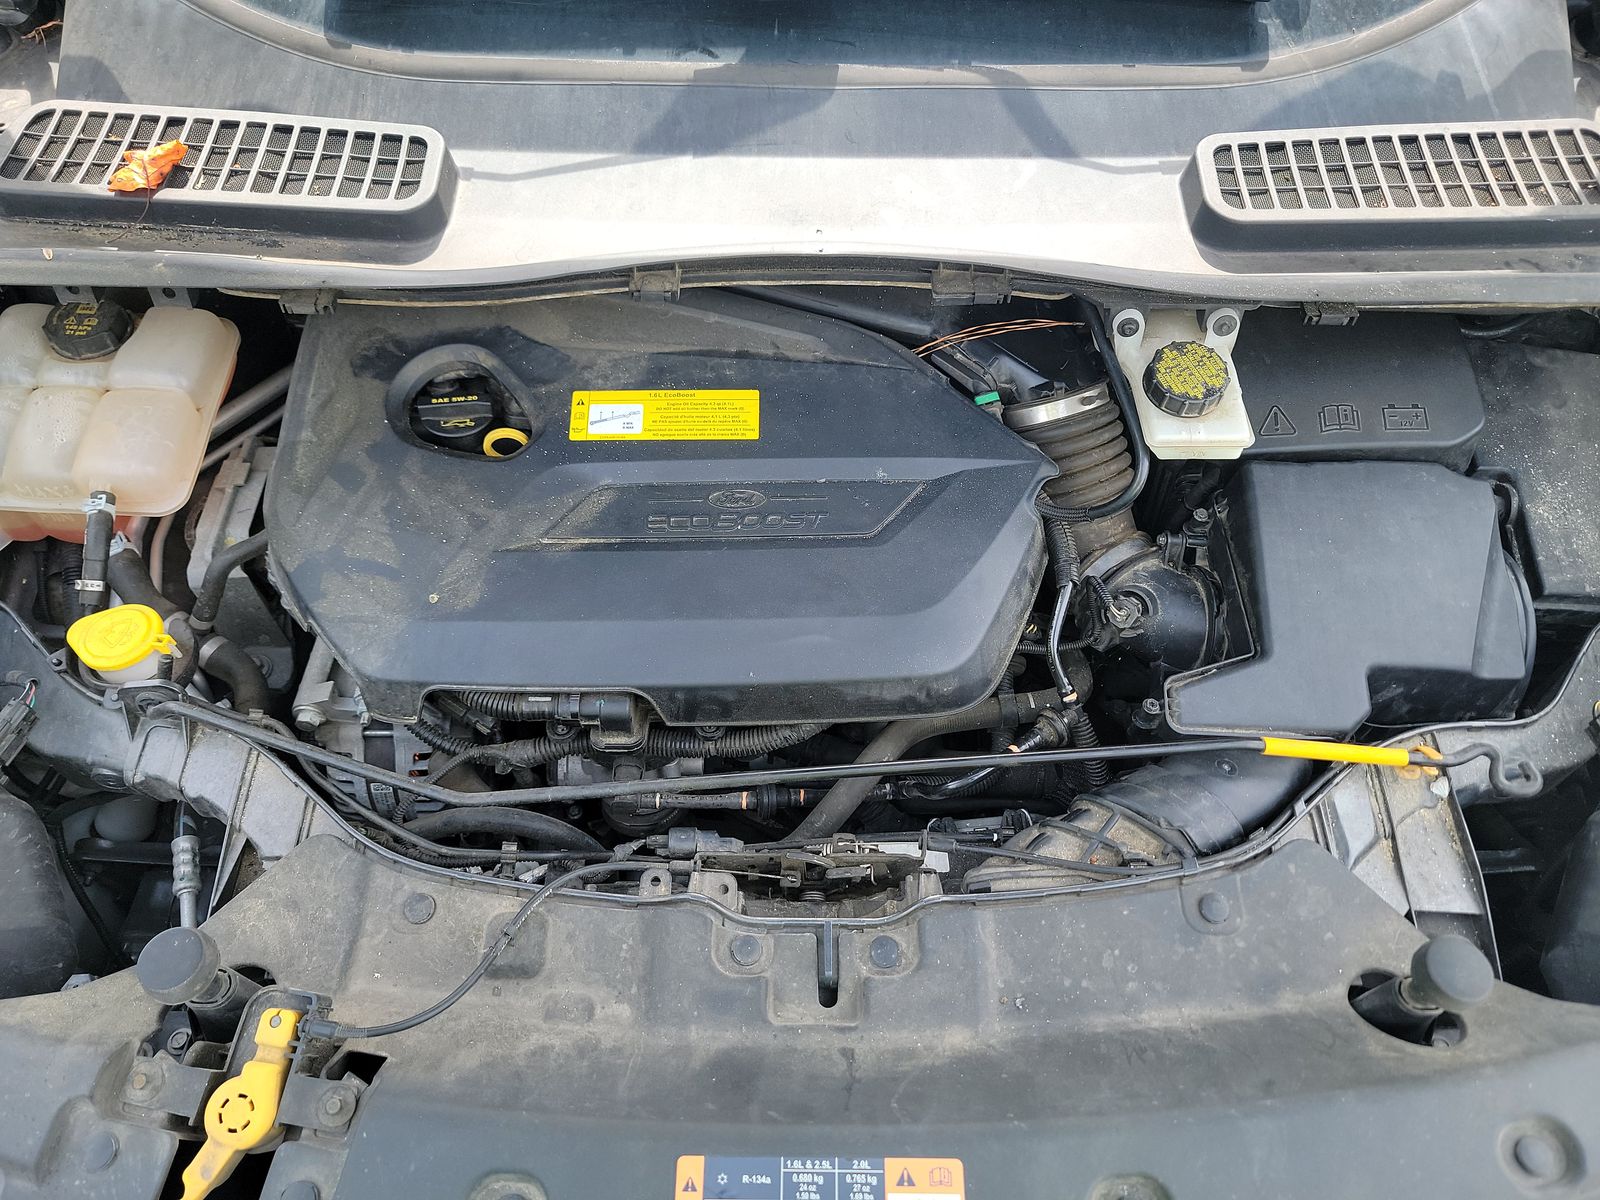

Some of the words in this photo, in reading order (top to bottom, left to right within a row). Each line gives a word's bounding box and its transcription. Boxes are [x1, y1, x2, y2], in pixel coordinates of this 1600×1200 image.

[715, 490, 761, 508] Ford
[645, 511, 830, 532] ECOBOOST
[786, 1159, 804, 1169] 1.6L
[805, 1160, 813, 1168] &
[814, 1160, 832, 1169] 2.5L
[852, 1160, 871, 1169] 2.0L
[742, 1174, 772, 1184] R-134a
[792, 1173, 813, 1182] 0.680
[813, 1173, 824, 1185] kg
[846, 1174, 866, 1183] 0.765
[867, 1174, 878, 1185] kg
